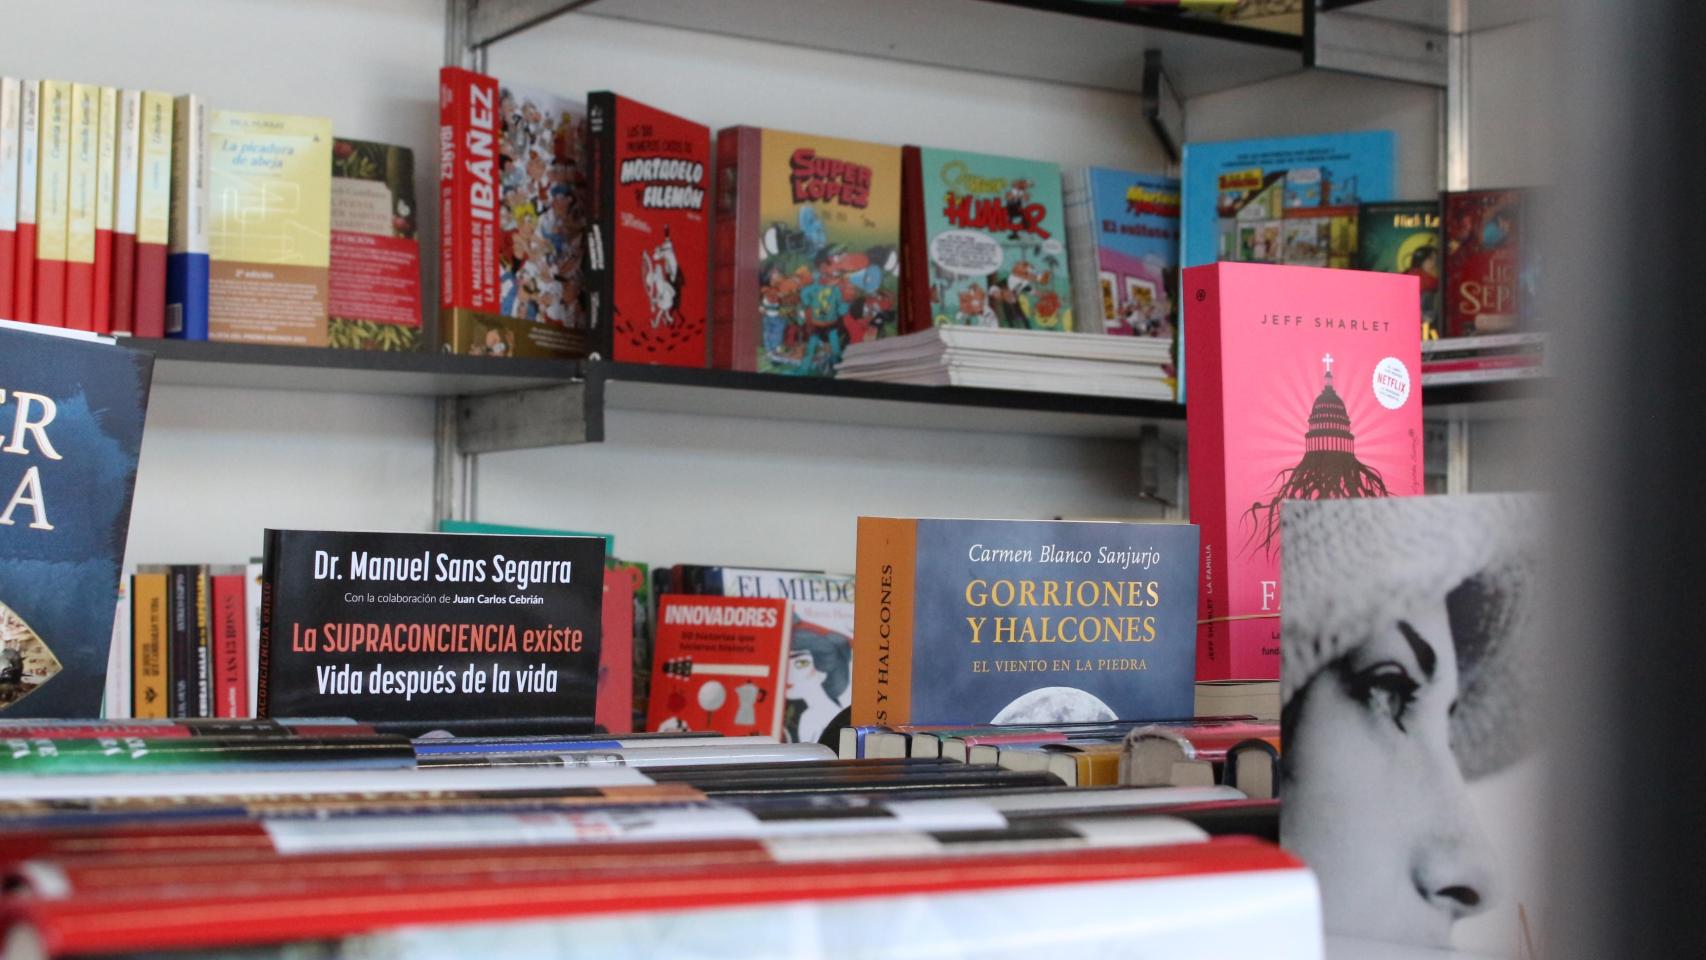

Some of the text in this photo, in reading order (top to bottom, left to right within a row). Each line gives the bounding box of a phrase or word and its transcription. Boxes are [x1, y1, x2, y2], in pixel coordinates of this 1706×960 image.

[466, 84, 494, 222] IBÁÑEZ
[620, 158, 704, 184] MORTADELO
[790, 148, 872, 189] SUPER
[642, 184, 704, 209] FILEMÓN
[471, 222, 483, 307] EL MAESTRO DE
[483, 224, 495, 303] LA HISTORIETA
[1261, 314, 1390, 332] JEFF SHARLET
[1378, 372, 1406, 394] NETFLIX
[314, 550, 572, 590] Dr. Manuel Sans Segarra
[968, 544, 1160, 570] Carmen Blanco Sanjurjo
[1204, 544, 1212, 580] FAMILIA
[344, 593, 544, 606] Con la colaboración de Juan Carlos Cebrián
[738, 575, 772, 598] EL
[966, 580, 1160, 608] GORRIONES
[1206, 582, 1213, 594] LA
[1260, 580, 1280, 611] F
[664, 604, 778, 628] INNOVADORES
[878, 564, 893, 686] HALCONES
[967, 616, 1156, 643] Y HALCONES
[293, 622, 582, 653] La SUPRACONCIENCIA existe
[258, 627, 270, 719] ACONCIENCIA
[972, 659, 1148, 672] EL VIENTO EN LA PIEDRA
[316, 664, 558, 701] Vida después de la vida
[877, 690, 888, 702] Y
